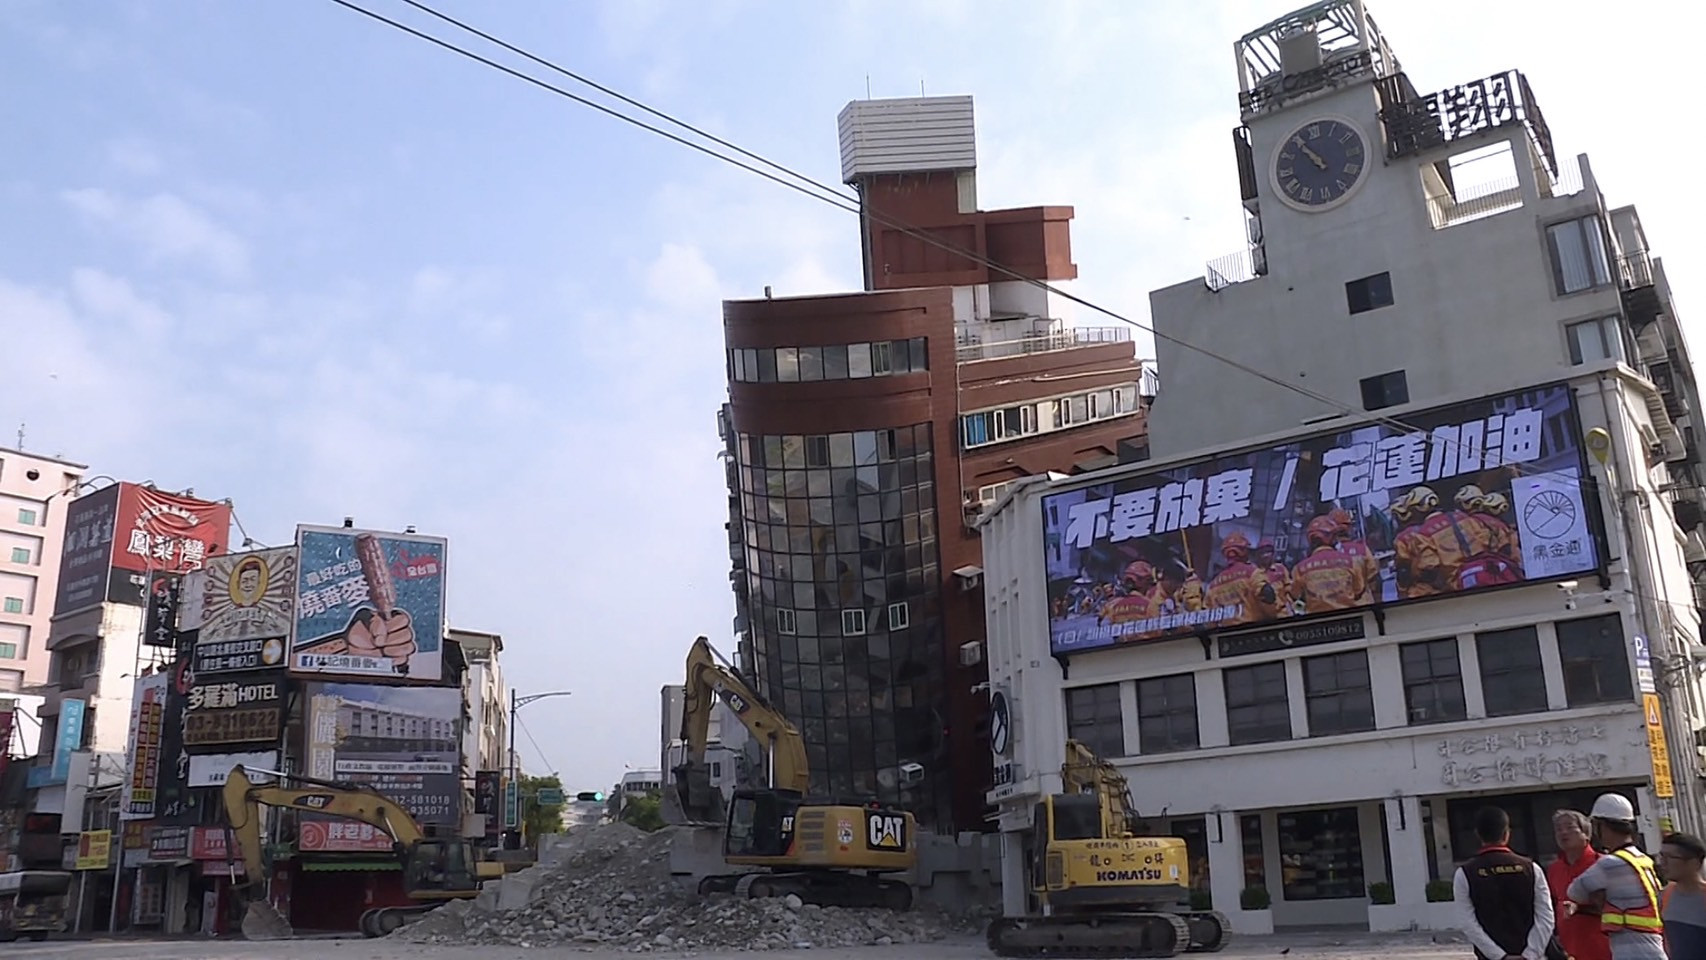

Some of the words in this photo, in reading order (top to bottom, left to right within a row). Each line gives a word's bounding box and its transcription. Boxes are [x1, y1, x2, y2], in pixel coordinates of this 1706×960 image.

[1065, 468, 1254, 549] 不要放棄
[1320, 407, 1544, 502] 花蓮加油
[187, 682, 238, 709] 多羅滿
[238, 684, 279, 702] HOTEL
[307, 796, 325, 807] CAT
[869, 815, 904, 847] CAT
[1096, 867, 1162, 882] KOMATSU
